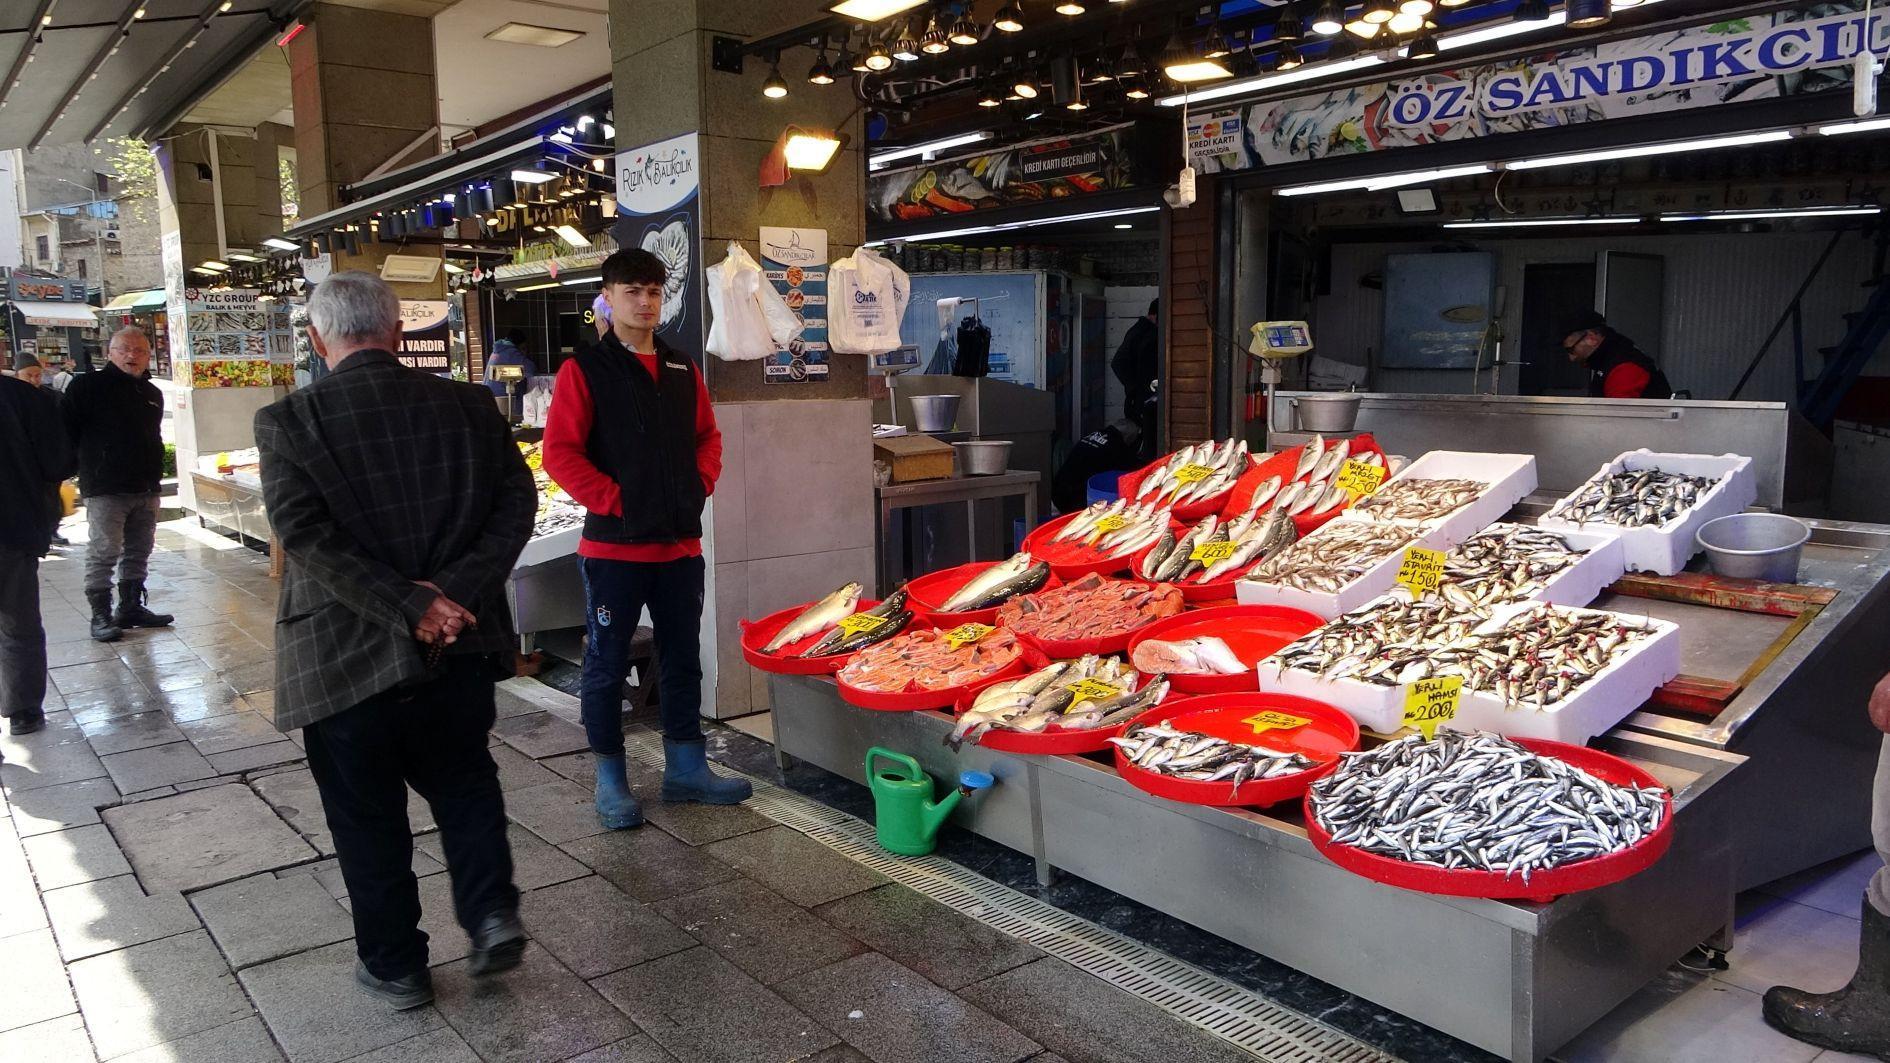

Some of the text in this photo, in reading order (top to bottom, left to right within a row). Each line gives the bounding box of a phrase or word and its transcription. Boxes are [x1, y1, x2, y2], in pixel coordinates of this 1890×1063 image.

[1393, 84, 1468, 125] ÖZ
[1189, 135, 1235, 149] KREDİ KARTI
[1024, 152, 1096, 174] KREDİ KARTI GEÇERLİDİR
[202, 294, 258, 303] YZC GROUP
[401, 309, 435, 318] ALIKÇILIK
[407, 340, 445, 352] VARDIR
[417, 356, 448, 368] VARDIR
